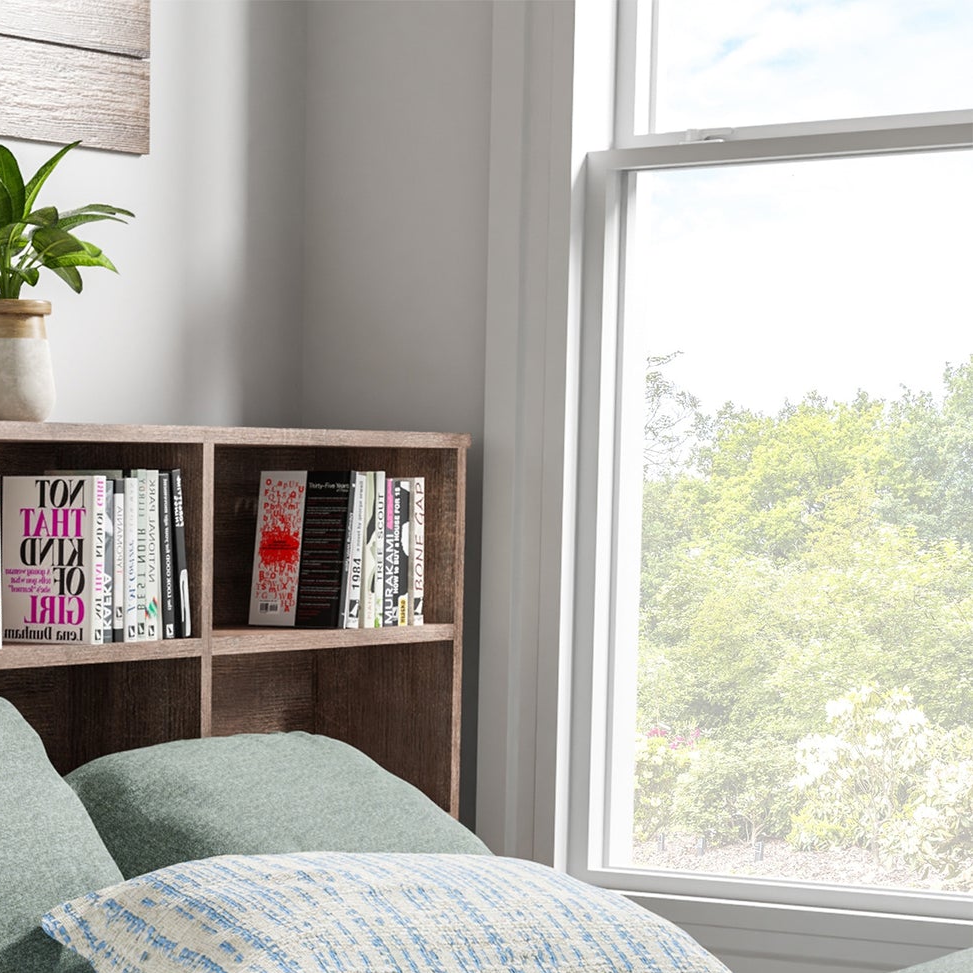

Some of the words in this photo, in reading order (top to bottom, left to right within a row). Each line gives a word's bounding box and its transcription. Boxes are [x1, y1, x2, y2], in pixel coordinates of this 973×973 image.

[309, 482, 335, 490] Thirty-Five
[415, 482, 424, 526] GAP
[357, 522, 362, 530] by
[351, 558, 361, 590] 1984
[393, 566, 399, 574] to
[415, 534, 423, 591] BONE
[385, 534, 394, 624] MURAKAMI
